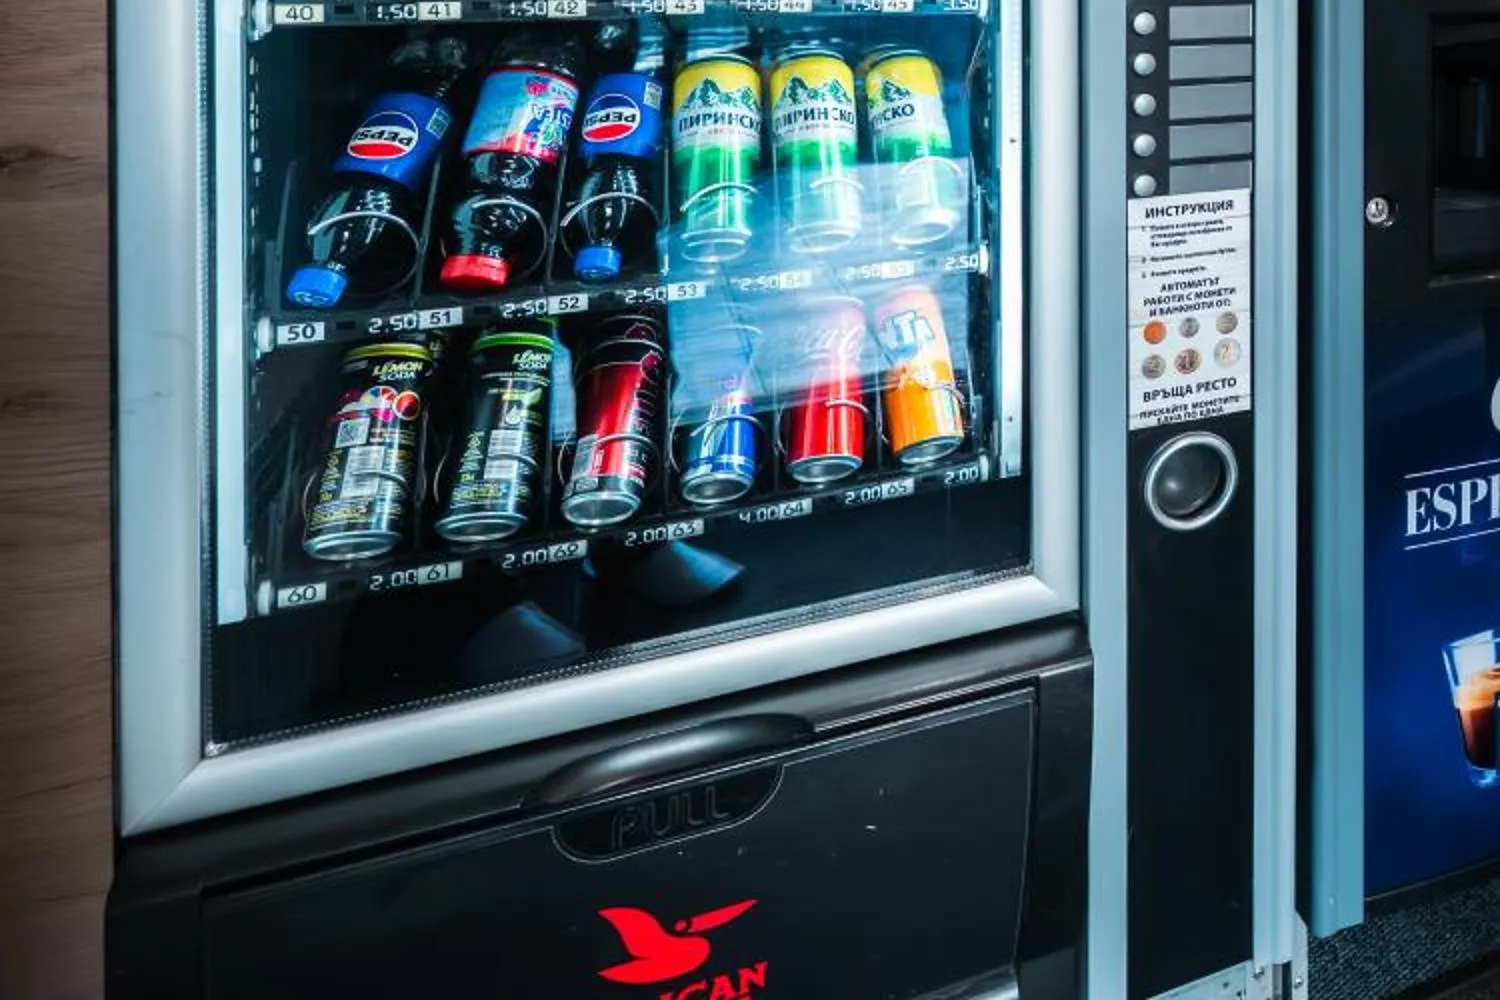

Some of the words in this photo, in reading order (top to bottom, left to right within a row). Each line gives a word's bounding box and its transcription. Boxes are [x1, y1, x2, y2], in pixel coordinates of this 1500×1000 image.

[285, 5, 314, 20] 40
[377, 4, 418, 19] 1.50
[429, 3, 450, 18] 41
[510, 0, 548, 16] 1.50
[554, 0, 579, 15] 42
[1145, 200, 1235, 219] ИНСТРУКЦИЯ
[559, 297, 580, 310] 52
[625, 287, 667, 303] 2.50
[431, 311, 451, 326] 51
[502, 299, 547, 318] 2.50
[287, 325, 316, 340] 50
[369, 315, 417, 333] 2.50
[372, 359, 424, 377] LEMON
[1143, 384, 1193, 402] ВРЪЩА
[1195, 378, 1237, 392] РЕСТО
[944, 465, 979, 486] 2.00
[845, 486, 880, 505] 2.00
[553, 543, 579, 560] 62
[625, 526, 668, 546] 2.00
[429, 563, 449, 581] 61
[502, 548, 548, 570] 2.00
[288, 586, 316, 602] 60
[370, 568, 417, 590] 2.00
[611, 785, 730, 850] PULL
